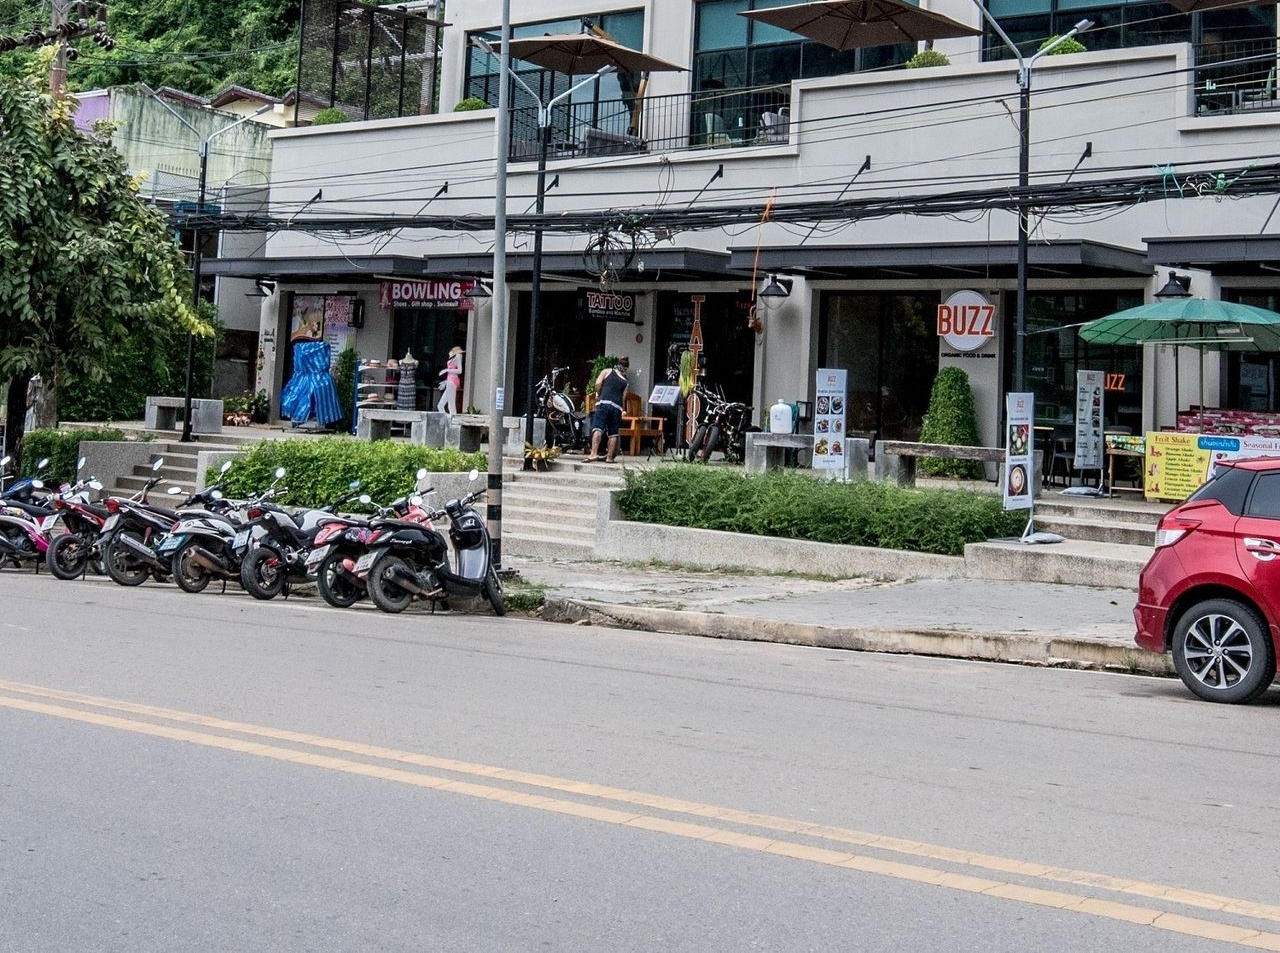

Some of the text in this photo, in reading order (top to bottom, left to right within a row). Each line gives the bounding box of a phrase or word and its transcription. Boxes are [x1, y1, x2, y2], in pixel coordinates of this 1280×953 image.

[392, 282, 461, 300] BOWLING
[586, 292, 633, 311] TATTOO
[937, 304, 995, 336] BUZZ
[1172, 436, 1190, 444] Shake
[1243, 441, 1272, 449] Seasonal
